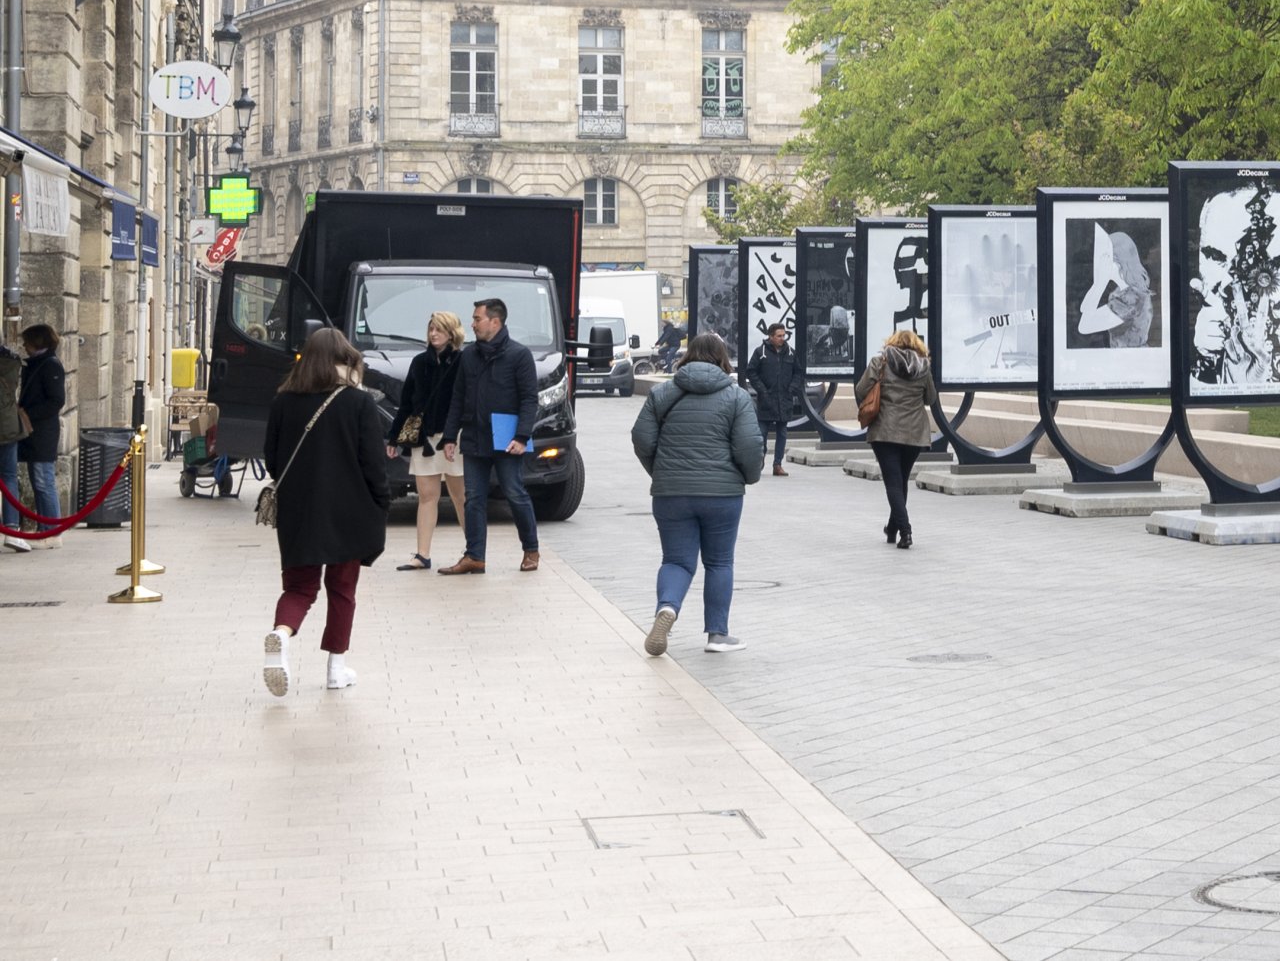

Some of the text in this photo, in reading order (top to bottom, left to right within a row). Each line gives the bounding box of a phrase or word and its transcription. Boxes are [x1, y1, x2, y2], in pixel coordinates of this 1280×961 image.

[159, 75, 219, 107] TBM
[1236, 169, 1270, 177] JCDecaux
[212, 228, 236, 260] ABAC
